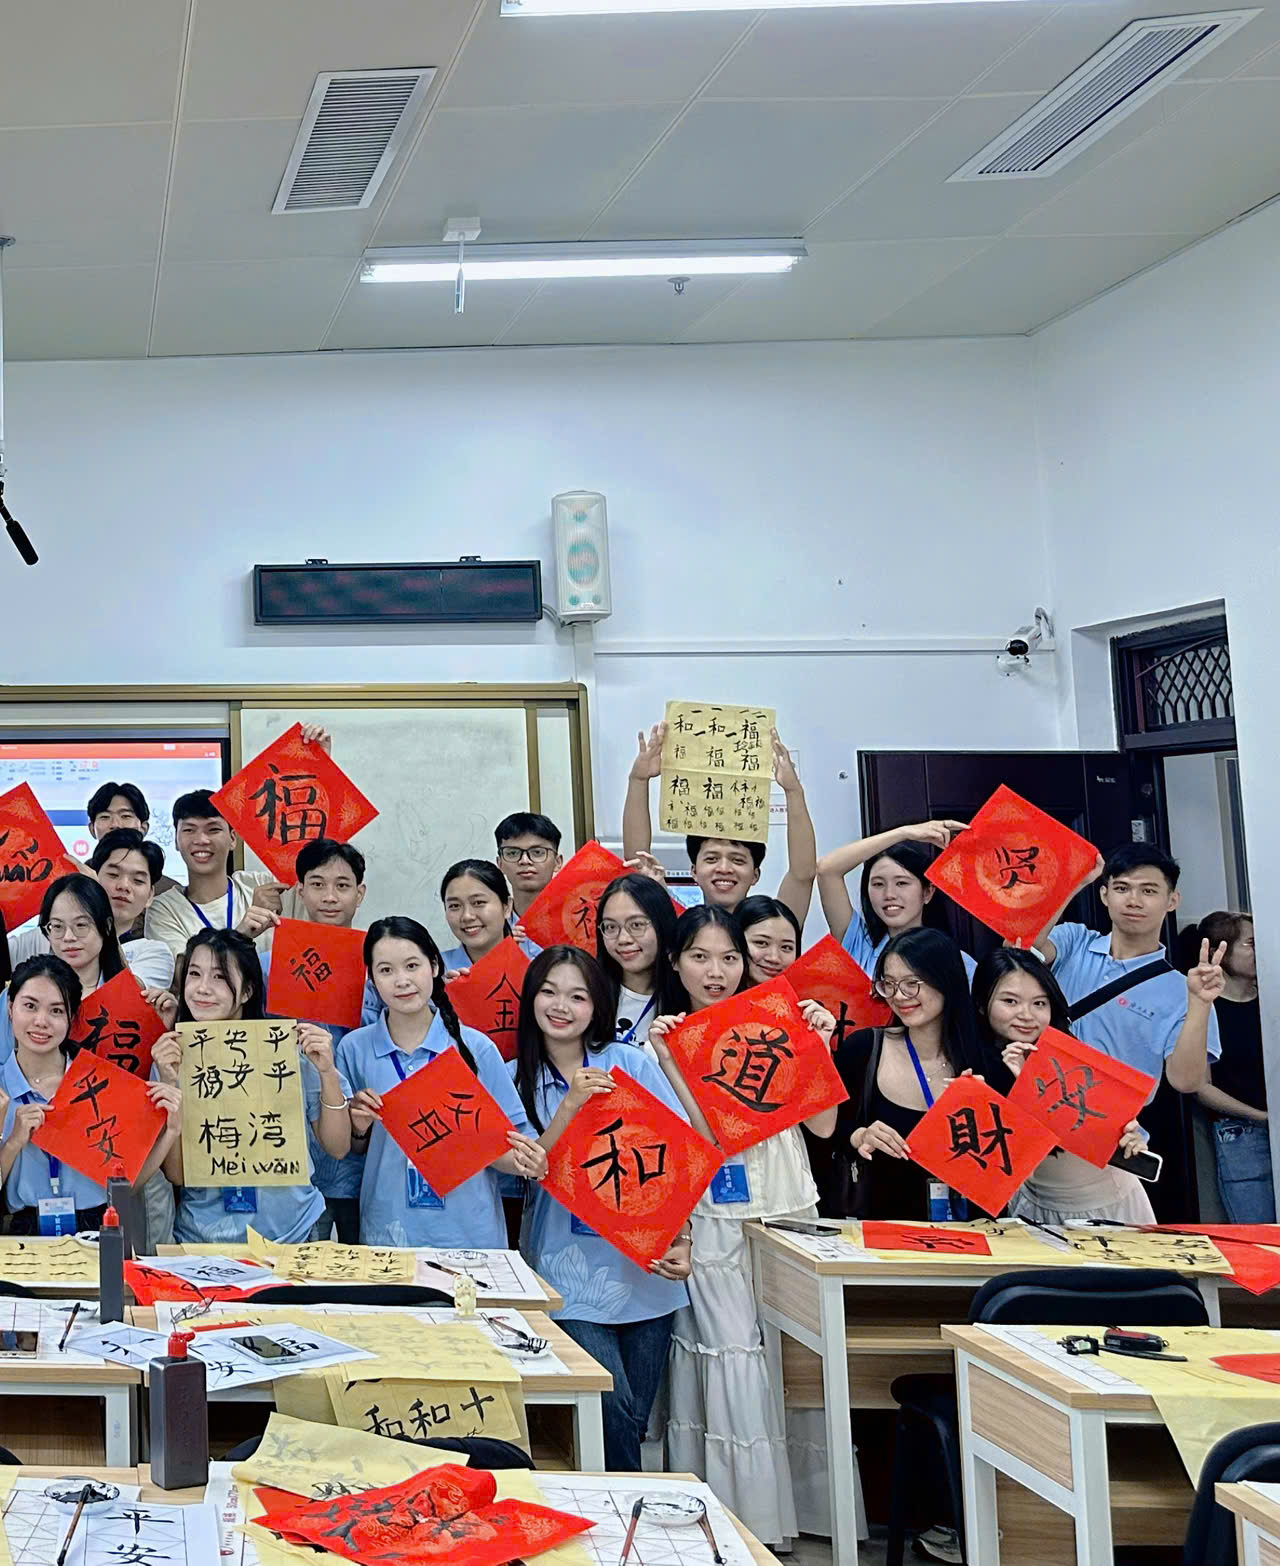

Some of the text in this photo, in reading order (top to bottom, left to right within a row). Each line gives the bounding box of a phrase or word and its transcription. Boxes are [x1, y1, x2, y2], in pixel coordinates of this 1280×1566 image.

[248, 762, 327, 846] 福
[993, 846, 1040, 890] 贤
[290, 946, 332, 992] 福
[702, 1028, 795, 1112] 道
[69, 1068, 123, 1167] 平安
[946, 1104, 1014, 1176] 財
[580, 1117, 667, 1209] 和
[104, 1507, 176, 1566] 平安
